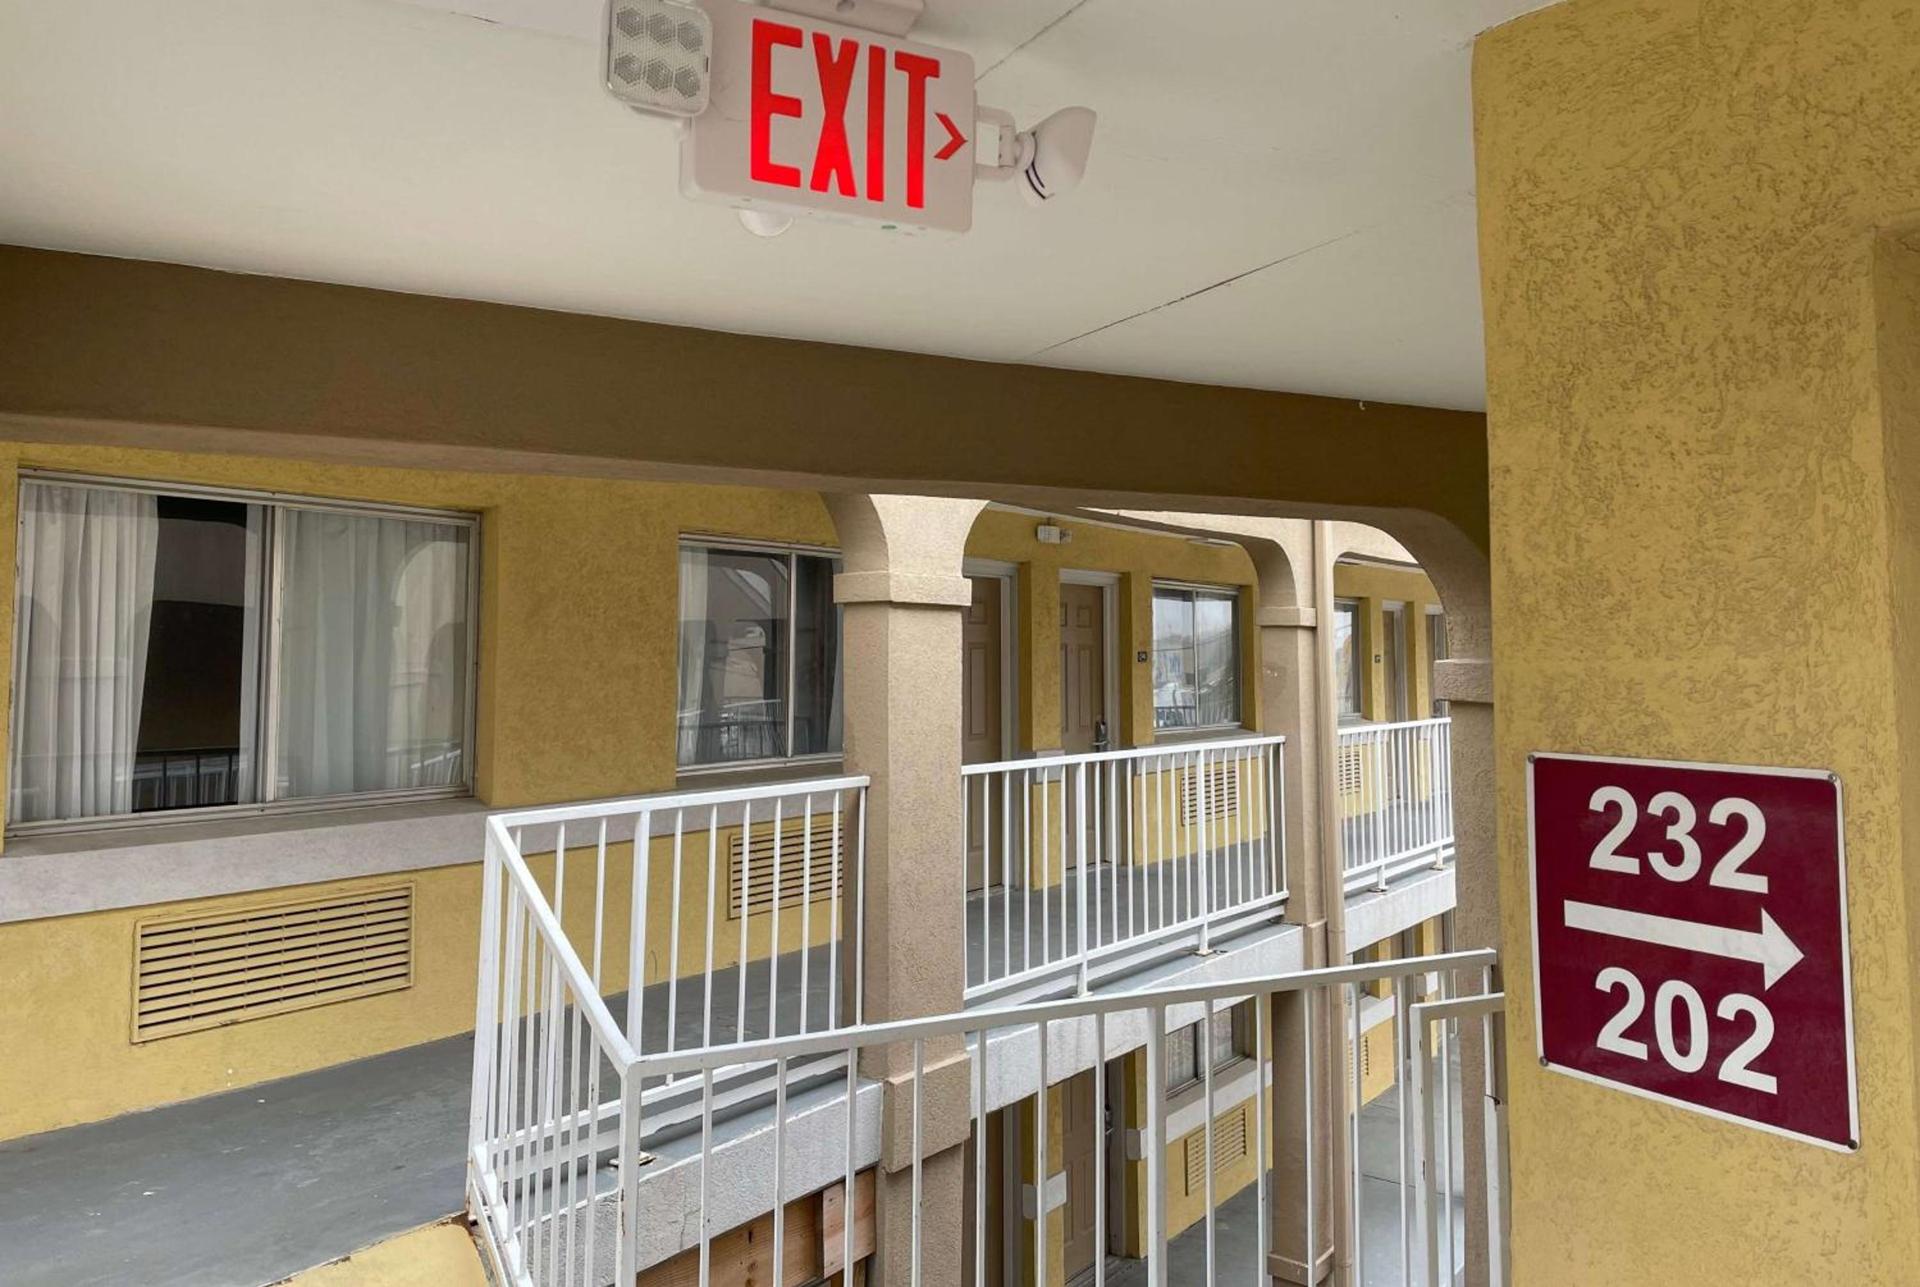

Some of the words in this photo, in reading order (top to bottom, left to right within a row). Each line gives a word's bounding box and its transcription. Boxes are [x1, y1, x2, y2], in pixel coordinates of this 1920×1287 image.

[751, 19, 940, 209] EXIT
[1589, 785, 1769, 894] 232
[1595, 966, 1778, 1095] 202
